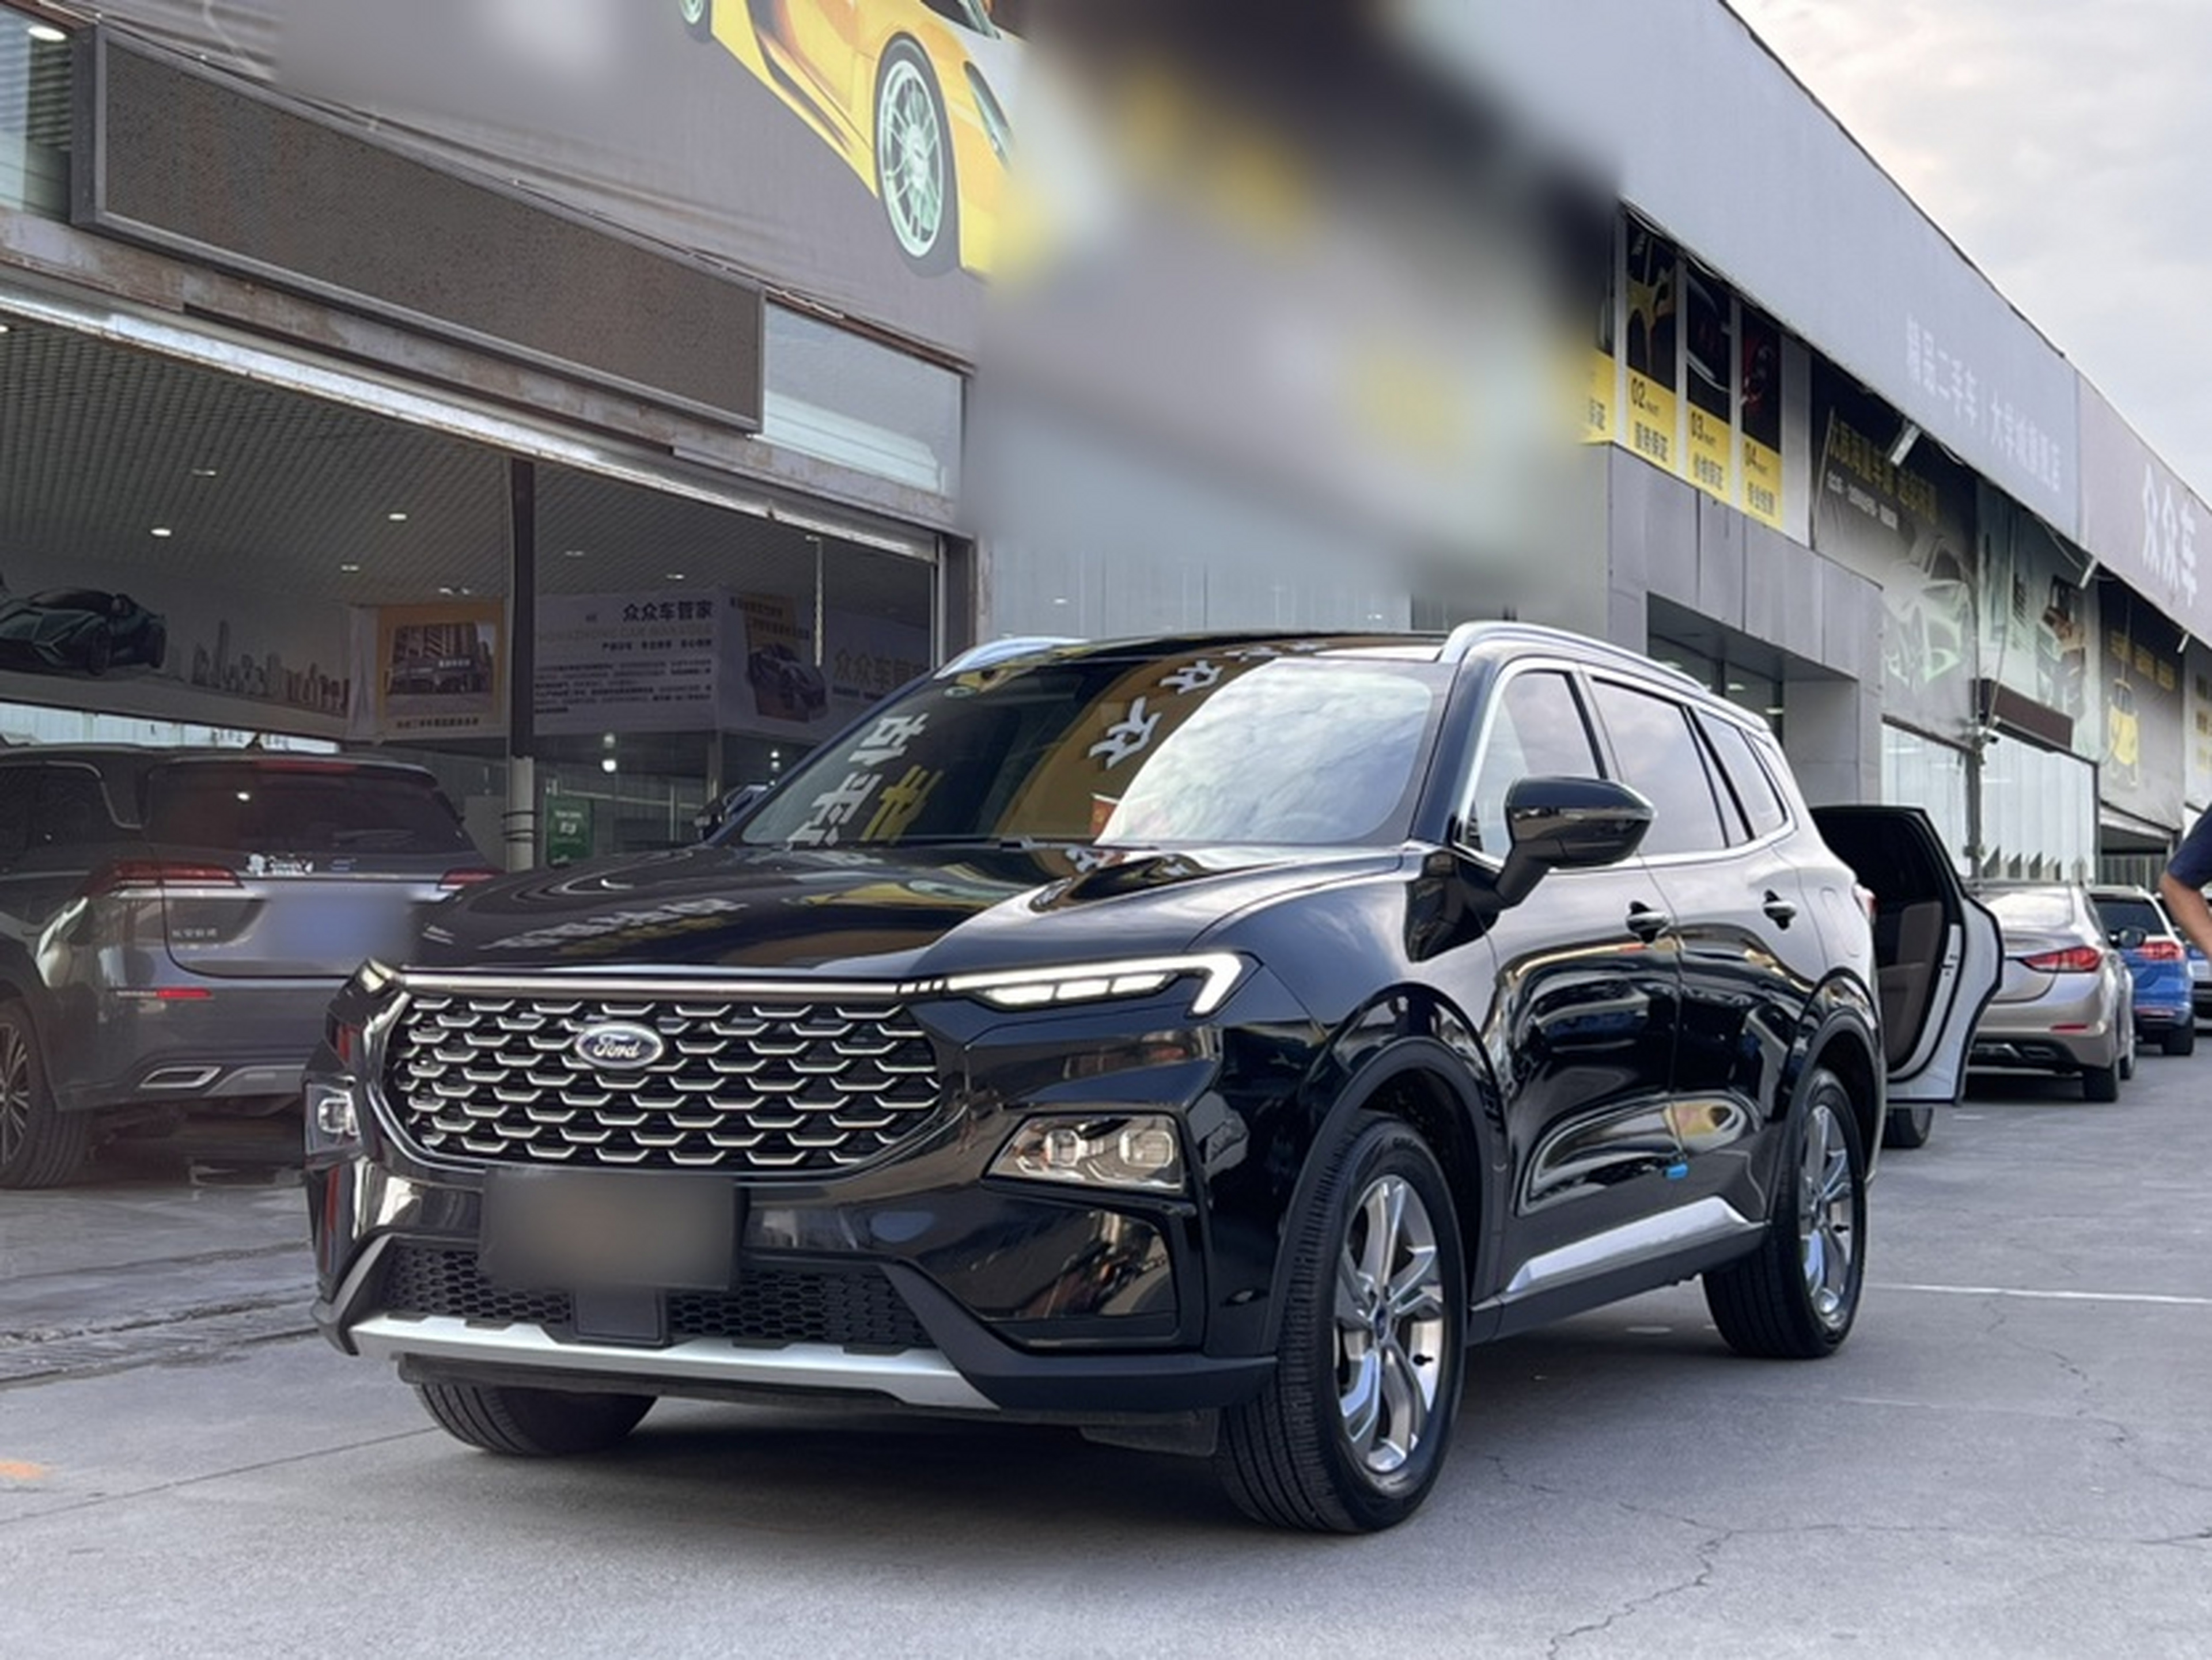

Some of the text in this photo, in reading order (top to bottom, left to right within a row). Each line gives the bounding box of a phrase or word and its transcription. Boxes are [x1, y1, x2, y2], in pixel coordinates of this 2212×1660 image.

[1631, 377, 1645, 409] 02
[1691, 411, 1703, 440] 03
[2142, 463, 2197, 608] 众众车
[623, 600, 713, 623] 众众车管家
[593, 1033, 641, 1059] Ford
